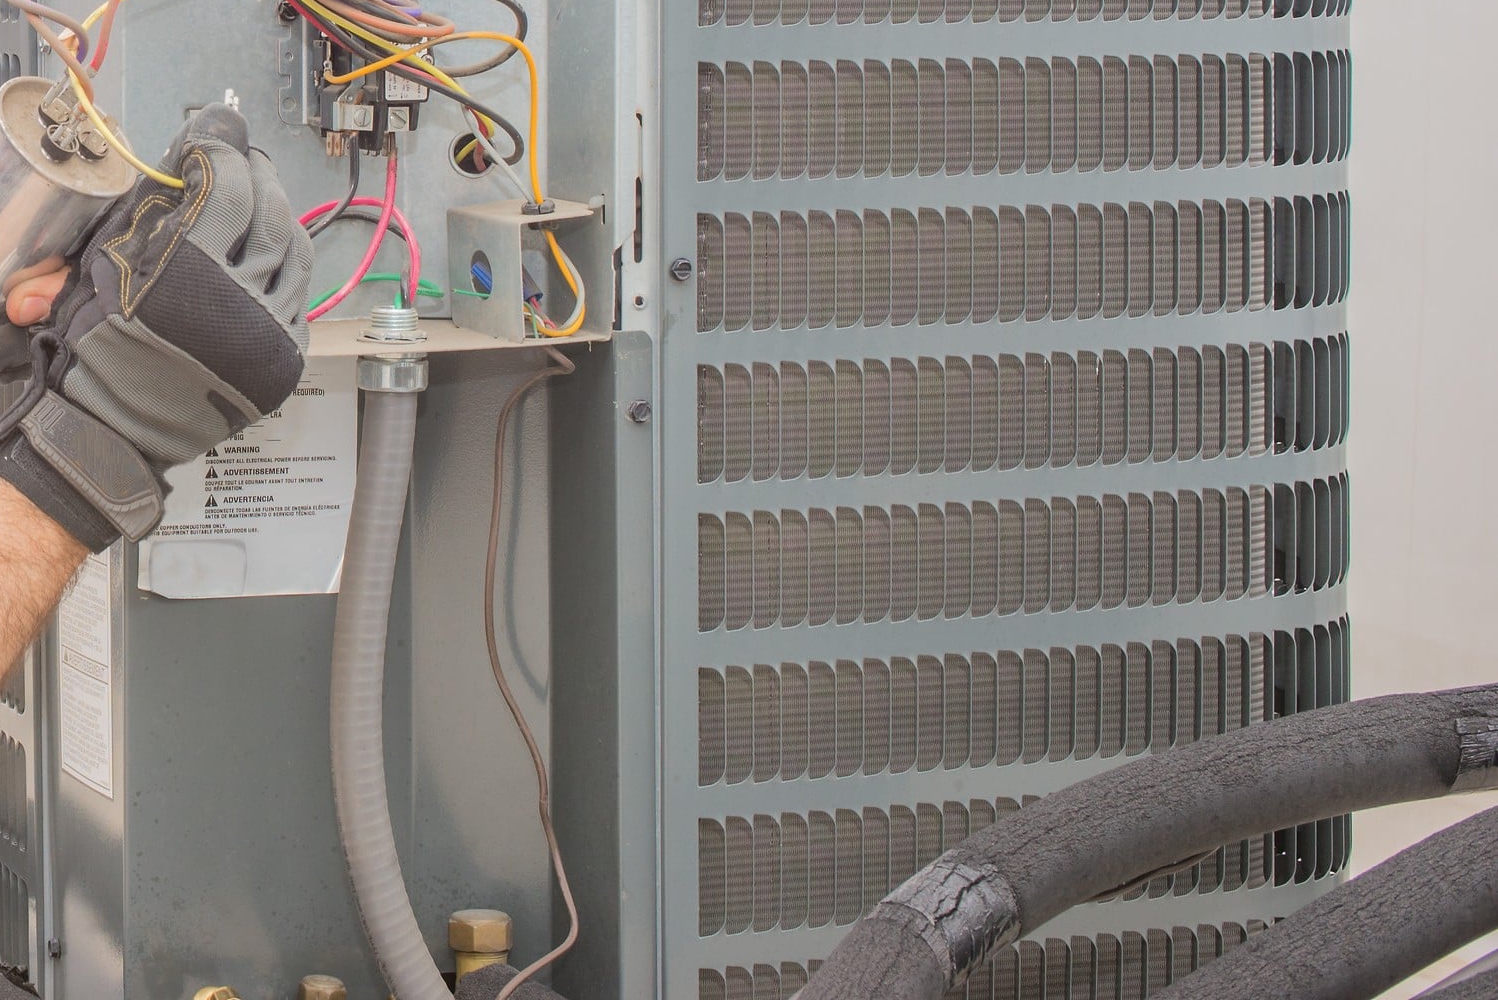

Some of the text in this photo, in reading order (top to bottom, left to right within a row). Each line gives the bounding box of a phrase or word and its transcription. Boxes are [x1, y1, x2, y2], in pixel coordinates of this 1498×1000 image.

[292, 388, 325, 397] REQUIRED)
[224, 468, 289, 476] ADVERTISSEMENT
[223, 495, 274, 504] ADVERTENCIA
